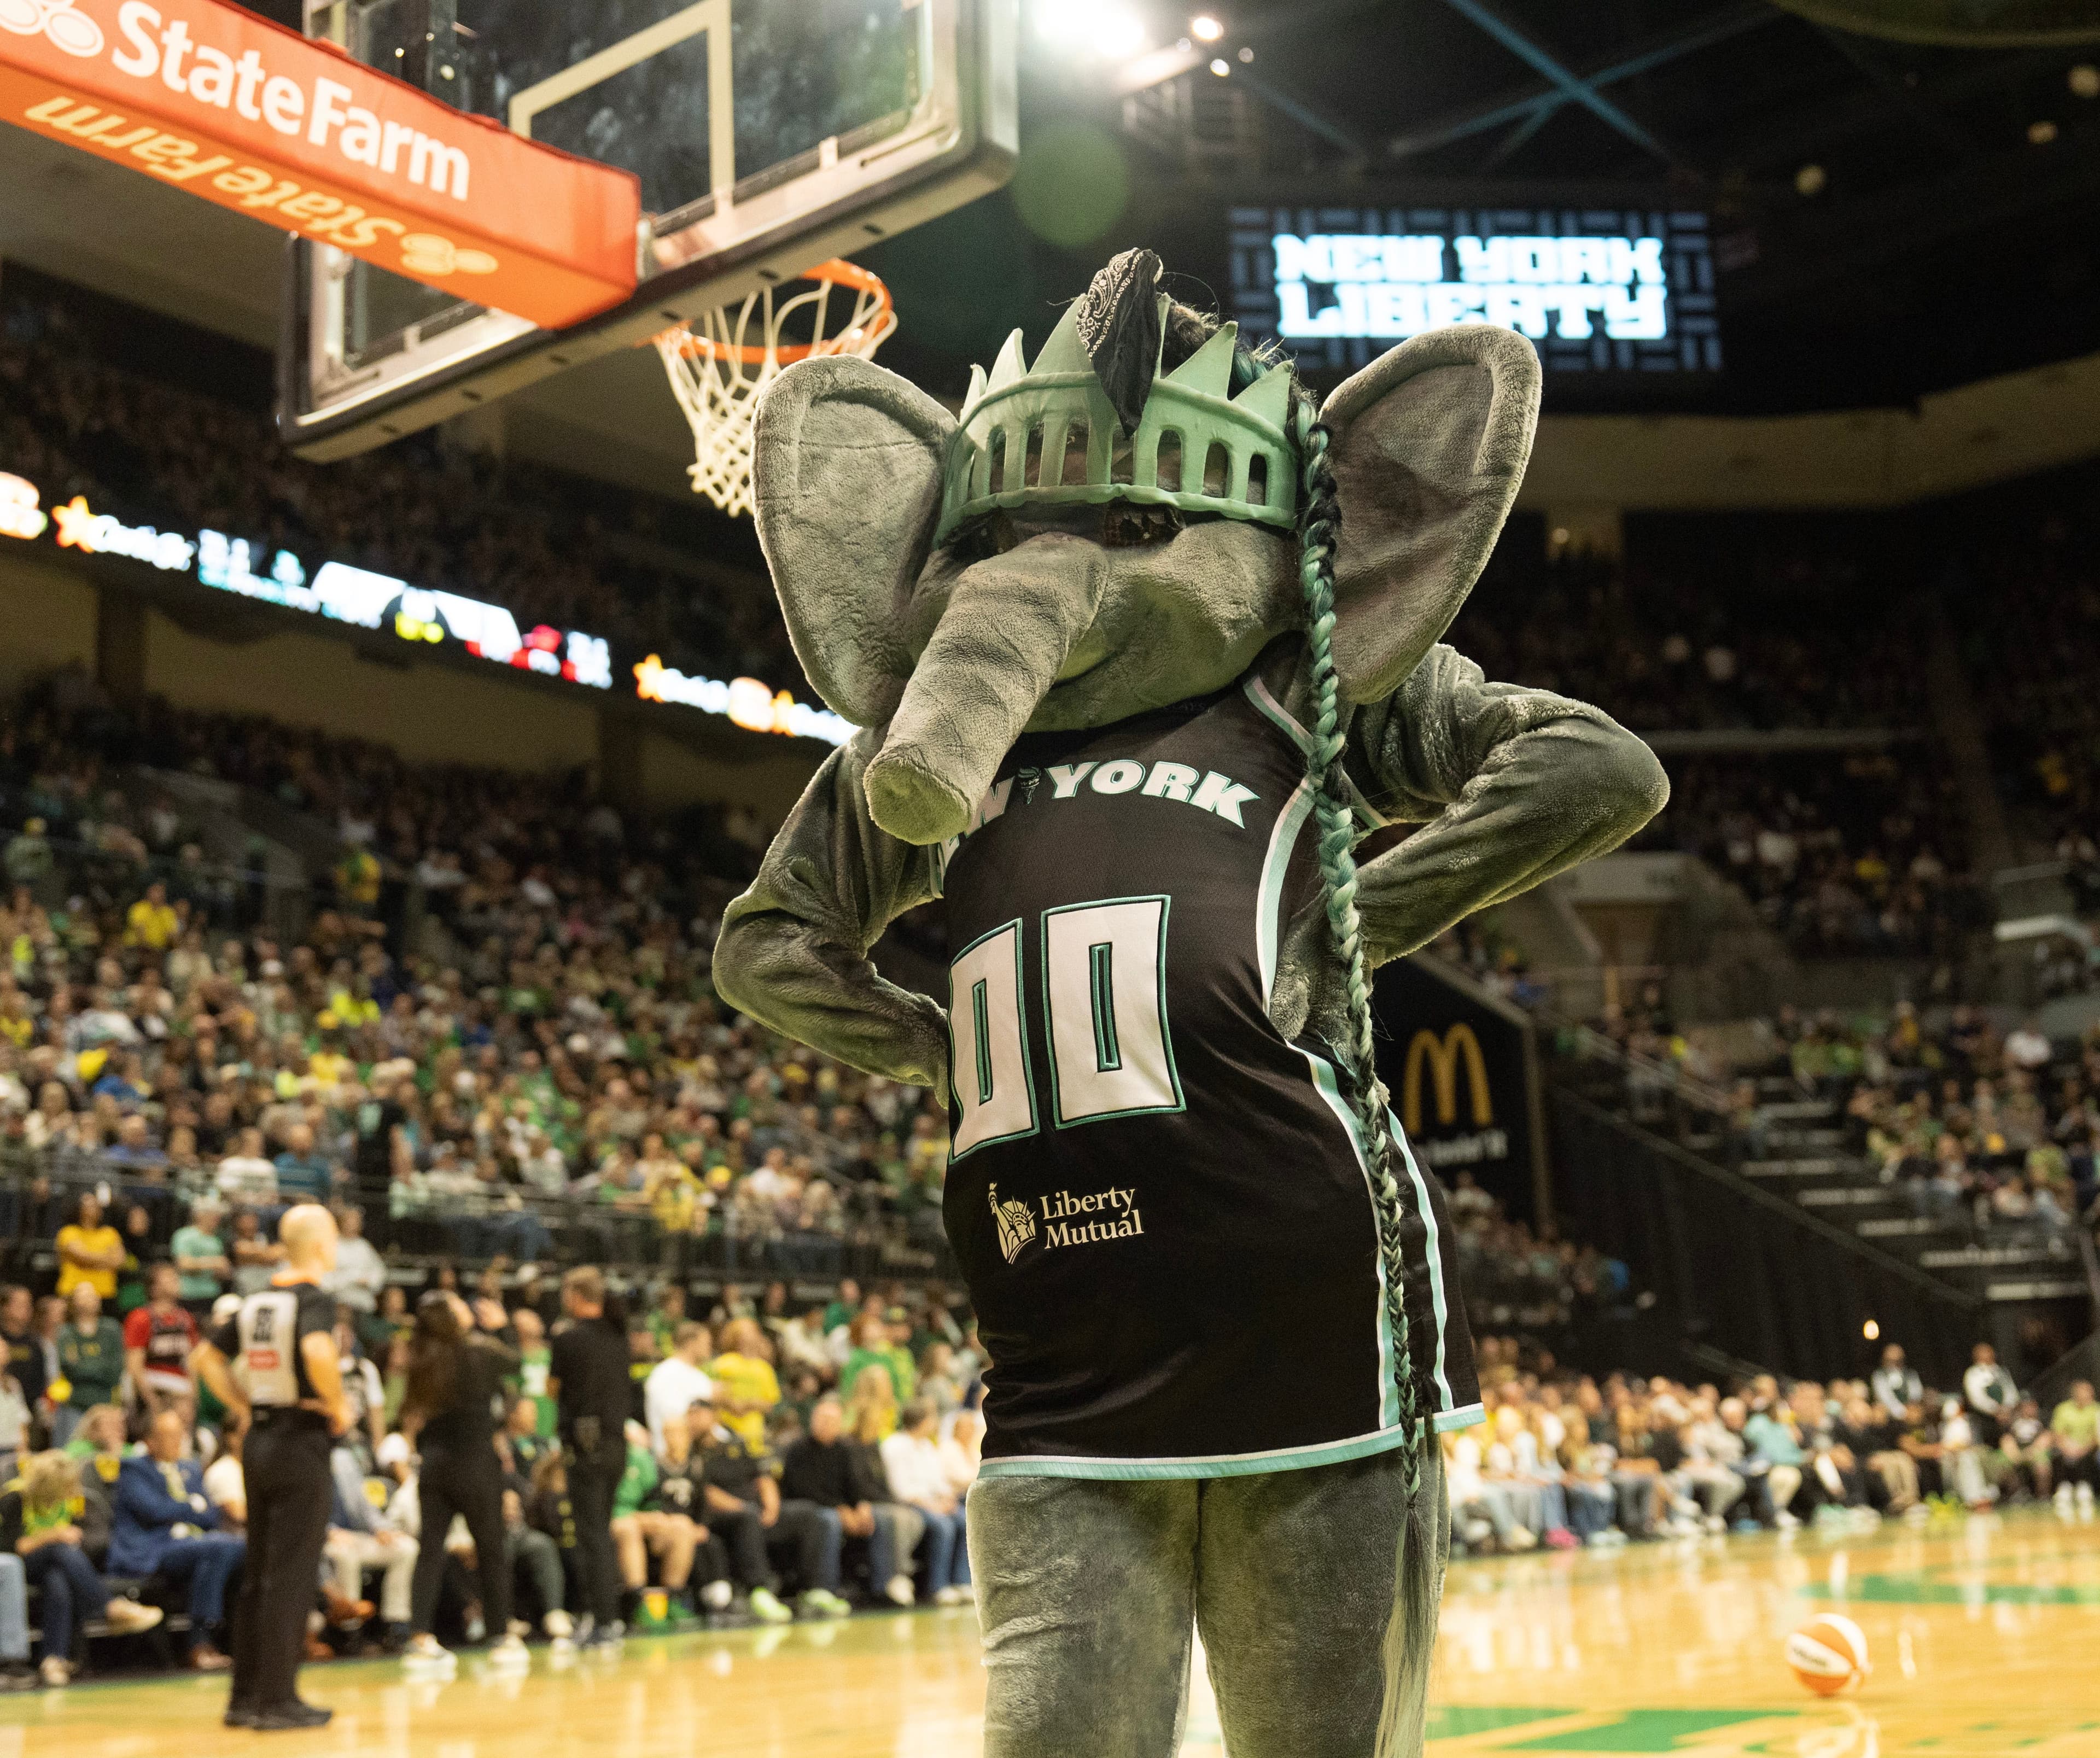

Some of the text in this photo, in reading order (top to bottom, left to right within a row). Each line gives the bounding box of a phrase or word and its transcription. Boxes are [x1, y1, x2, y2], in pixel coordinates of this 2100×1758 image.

[1272, 233, 1666, 284] NEW YORK
[1274, 281, 1667, 339] LIBERTY
[1044, 759, 1261, 829] YORK
[947, 894, 1187, 1165] 00
[1039, 1186, 1136, 1220] Liberty
[1043, 1210, 1144, 1249] Mutual
